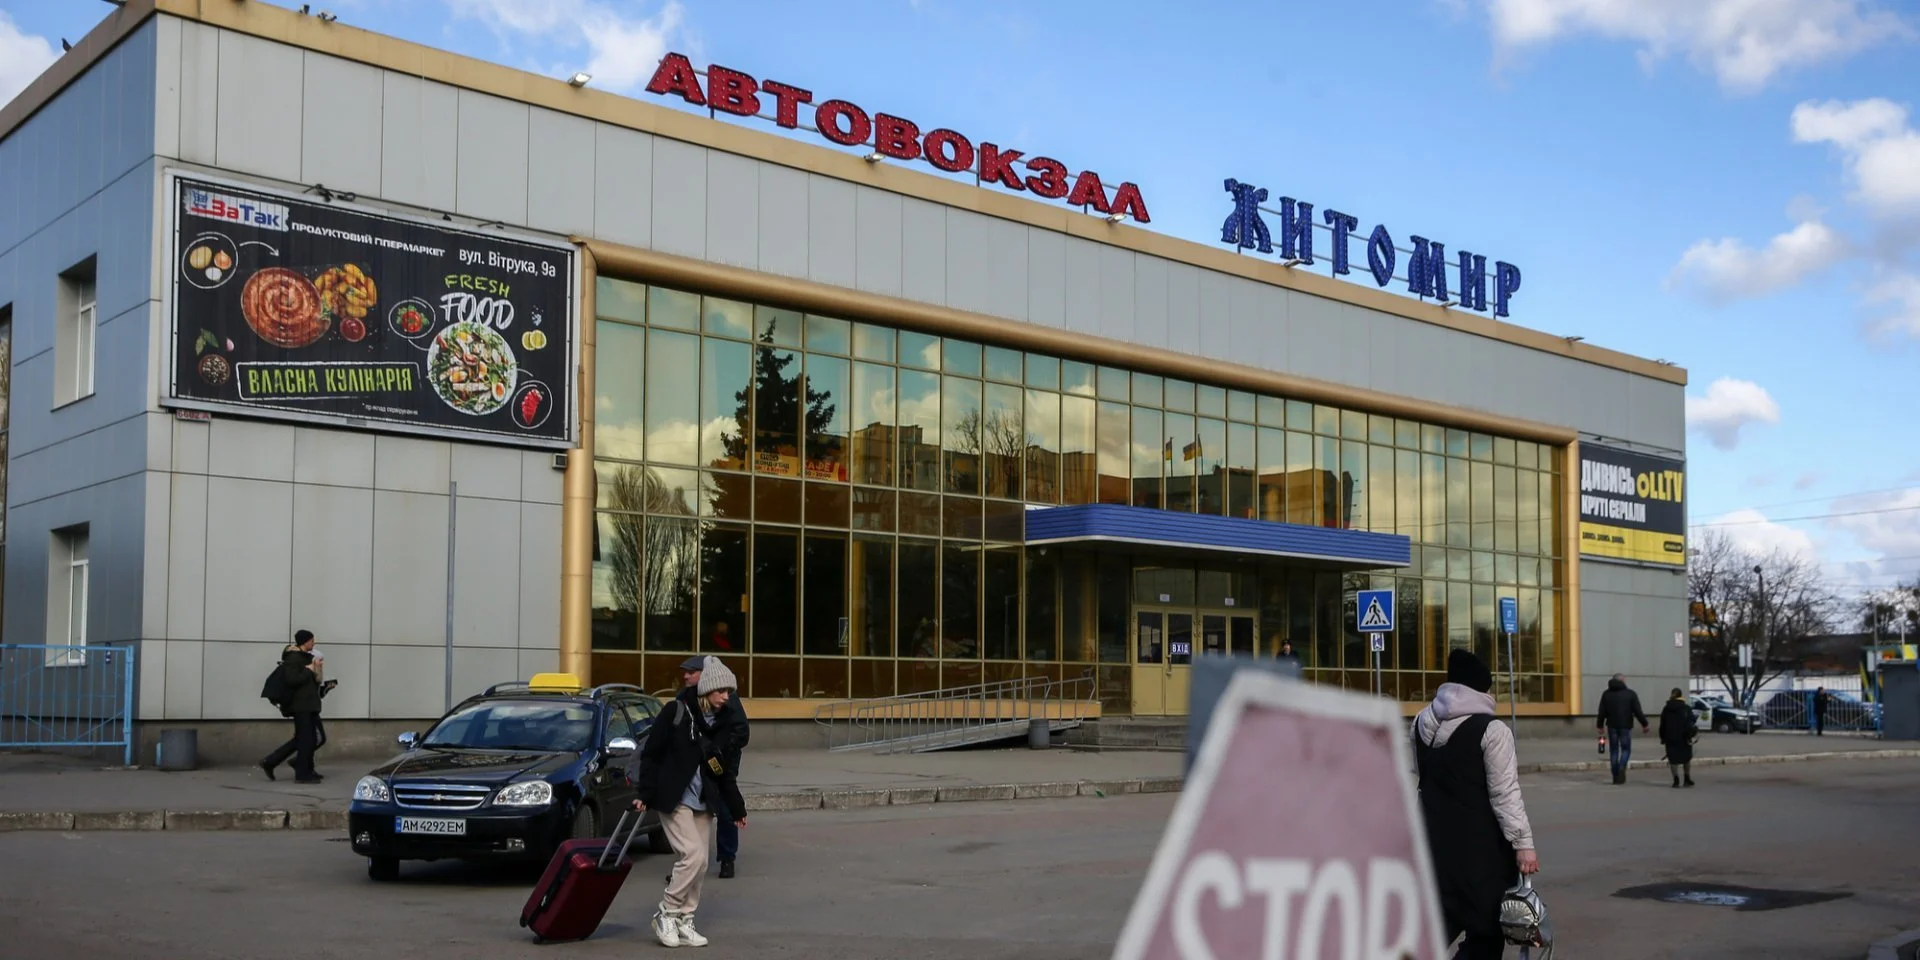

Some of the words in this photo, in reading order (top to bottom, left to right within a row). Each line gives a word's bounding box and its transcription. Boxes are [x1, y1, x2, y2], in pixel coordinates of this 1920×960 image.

[645, 51, 1151, 223] АВТОВОКЗАЛ
[1220, 178, 1521, 317] ЖИТОМИР
[210, 198, 280, 227] ЗаТак
[291, 222, 373, 244] ПРОДУКТОВИЙ
[375, 238, 445, 257] ГІПЕРМАРКЕТ
[459, 249, 485, 266] вул.
[488, 252, 539, 276] Вітрука,
[541, 261, 556, 277] 9а
[444, 274, 511, 298] FRESH
[439, 292, 515, 330] FOOD
[248, 368, 319, 394] ВЛАСНА
[326, 367, 413, 392] КУЛІНАРІЯ
[1581, 459, 1635, 495] ДИВИСЬ
[1636, 470, 1684, 503] OLLTV
[1581, 494, 1609, 518] КРУТІ
[1609, 499, 1646, 523] СЕРІАЛИ
[1172, 643, 1190, 654] ВХІД
[420, 820, 445, 832] 4292
[1172, 851, 1422, 960] STOP
